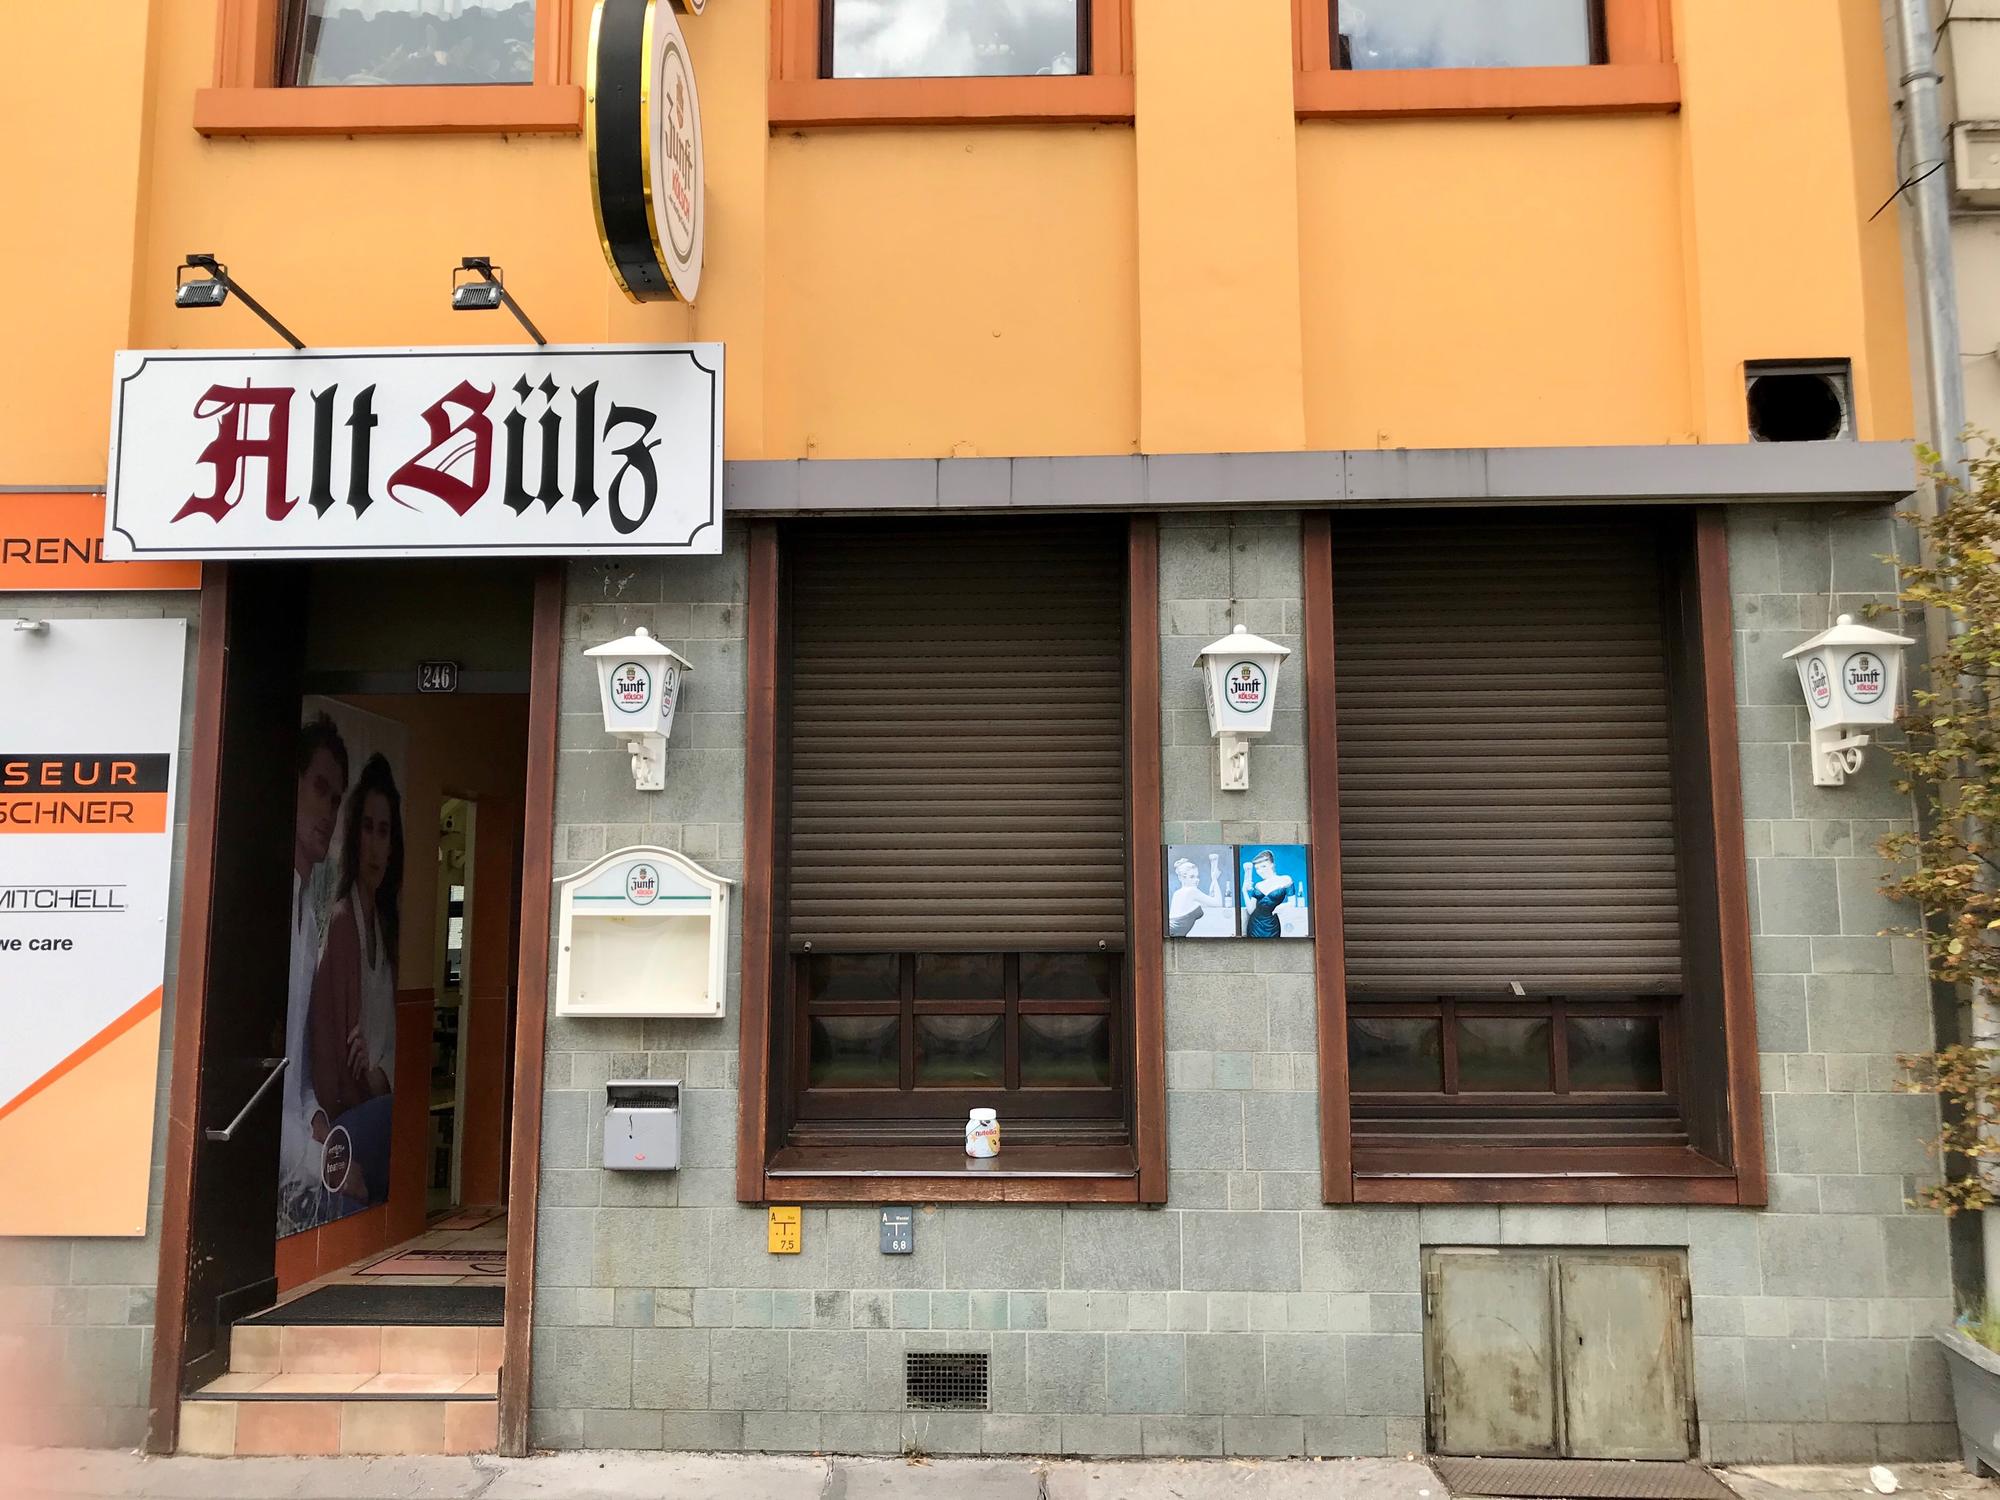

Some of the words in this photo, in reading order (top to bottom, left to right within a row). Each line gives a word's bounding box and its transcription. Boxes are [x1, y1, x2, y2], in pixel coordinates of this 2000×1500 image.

[169, 377, 379, 525] Alt
[386, 372, 662, 535] Sülz
[423, 665, 450, 689] 246
[1848, 668, 1880, 685] Zunft
[616, 678, 646, 695] Zunft
[1230, 677, 1261, 694] Zunft
[631, 877, 655, 891] Zunft
[28, 937, 73, 951] care
[770, 1212, 777, 1222] A
[882, 1213, 888, 1222] A
[780, 1240, 794, 1250] 7,5
[892, 1240, 907, 1251] 6,8
